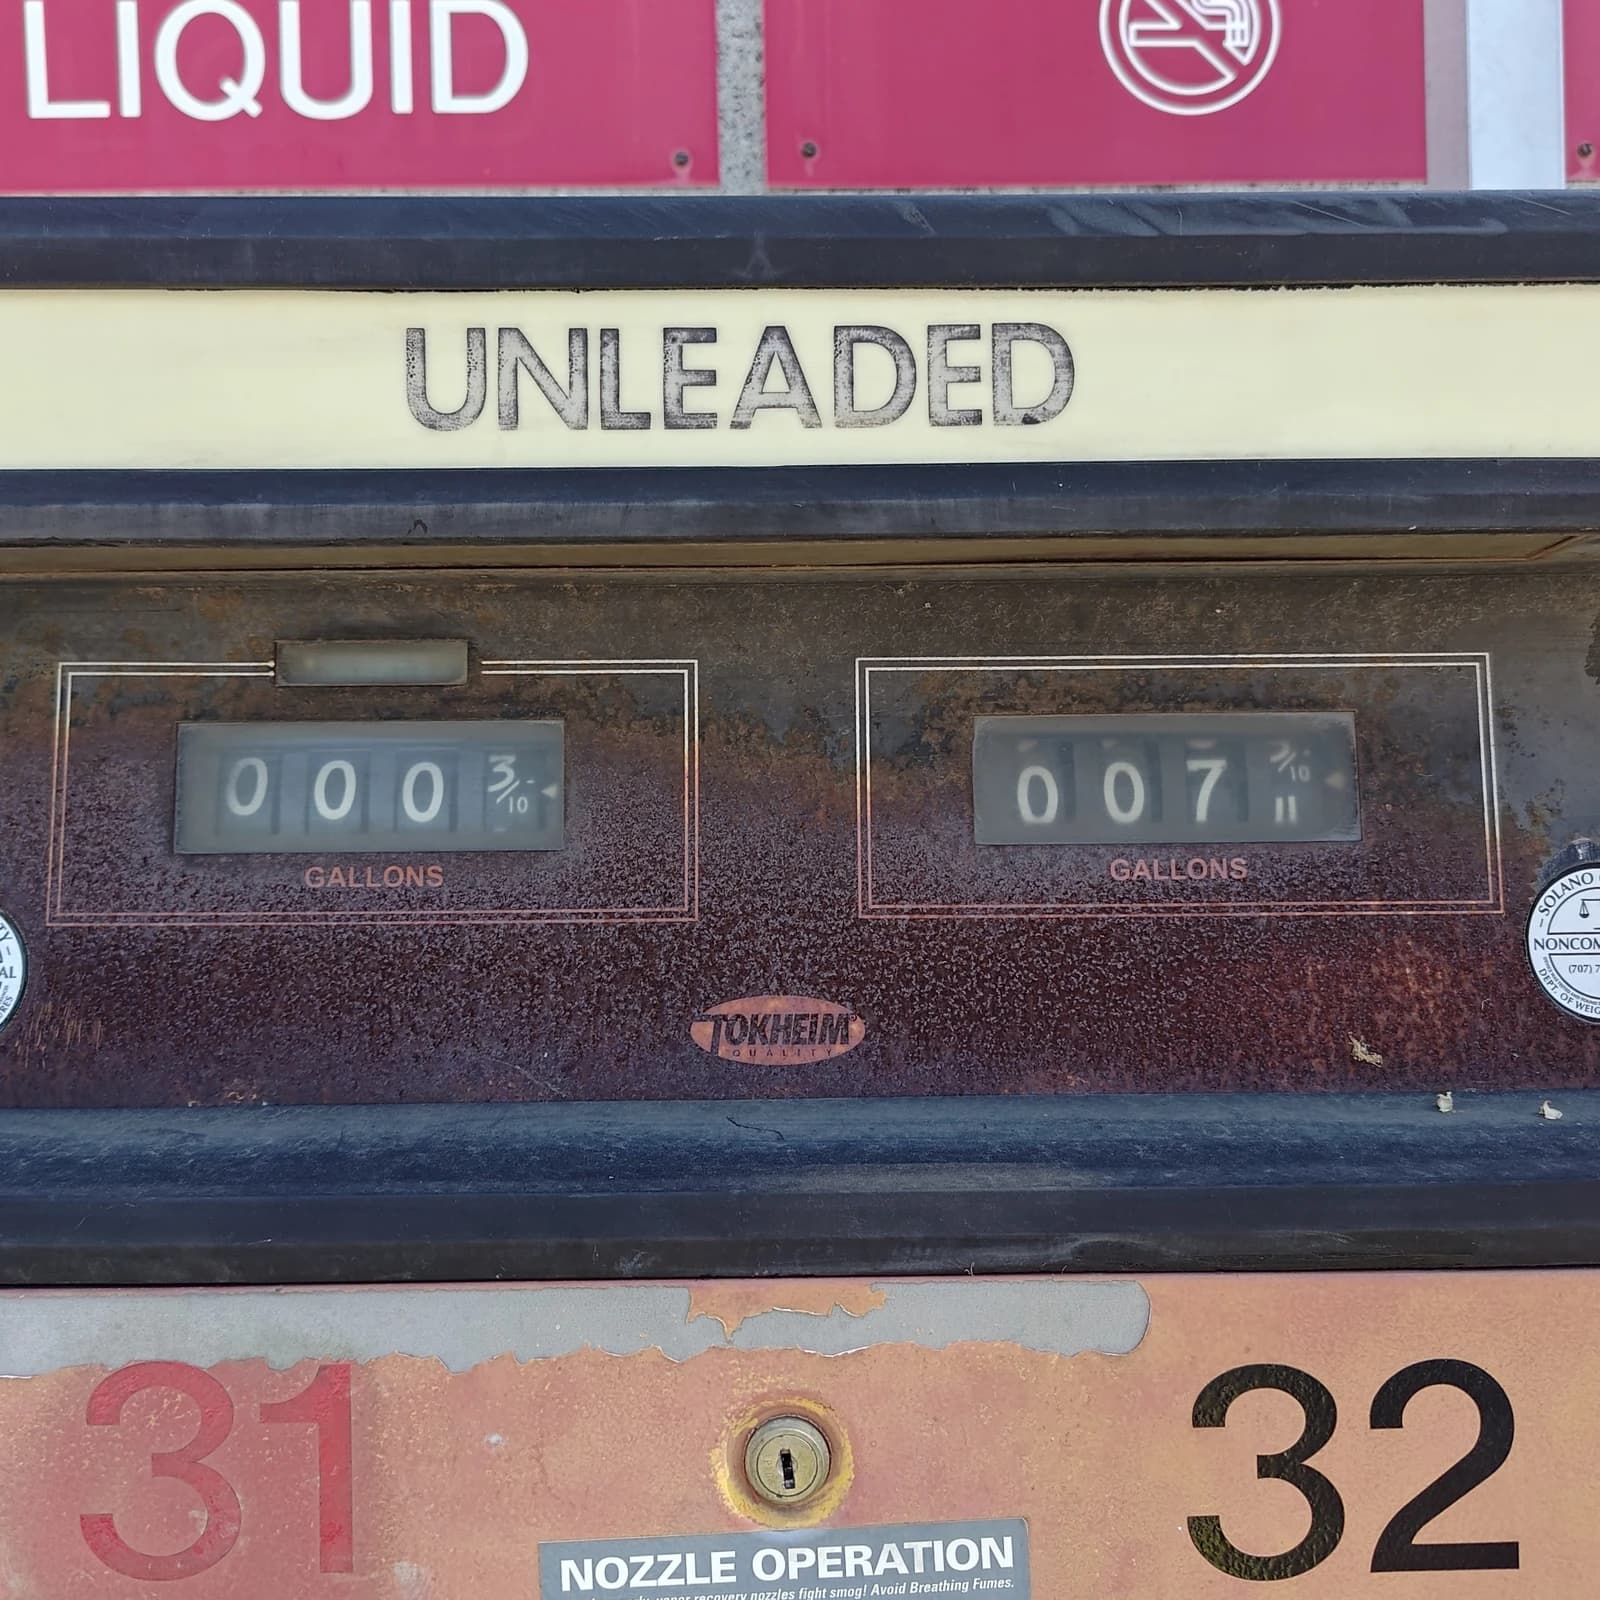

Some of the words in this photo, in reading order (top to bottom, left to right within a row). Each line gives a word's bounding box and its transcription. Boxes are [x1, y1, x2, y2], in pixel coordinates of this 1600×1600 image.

[23, 0, 528, 120] LIQUID
[405, 322, 1075, 431] UNLEADED
[226, 757, 268, 816] 0
[313, 760, 357, 820] 0
[402, 761, 444, 823] 0
[1016, 765, 1059, 824] 0
[1103, 761, 1145, 824] 0
[1186, 758, 1227, 823] 7
[305, 865, 444, 888] GALLONS
[1110, 857, 1248, 881] GALLONS
[1538, 872, 1594, 917] SOLANO
[1568, 964, 1593, 974] (707)
[1560, 992, 1574, 1005] OF
[695, 1013, 850, 1057] TOKHEIM
[732, 1048, 833, 1057] QUALITY
[80, 1360, 353, 1581] 31
[1187, 1358, 1520, 1581] 32
[560, 1550, 737, 1592] NOZZLE
[752, 1536, 1014, 1582] OPERATION
[750, 1588, 796, 1600] nozzles
[798, 1587, 827, 1600] fight
[829, 1584, 868, 1599] smog!
[870, 1581, 908, 1597] Avoid
[909, 1579, 970, 1594] Breathing
[972, 1577, 1015, 1590] Fumes.
